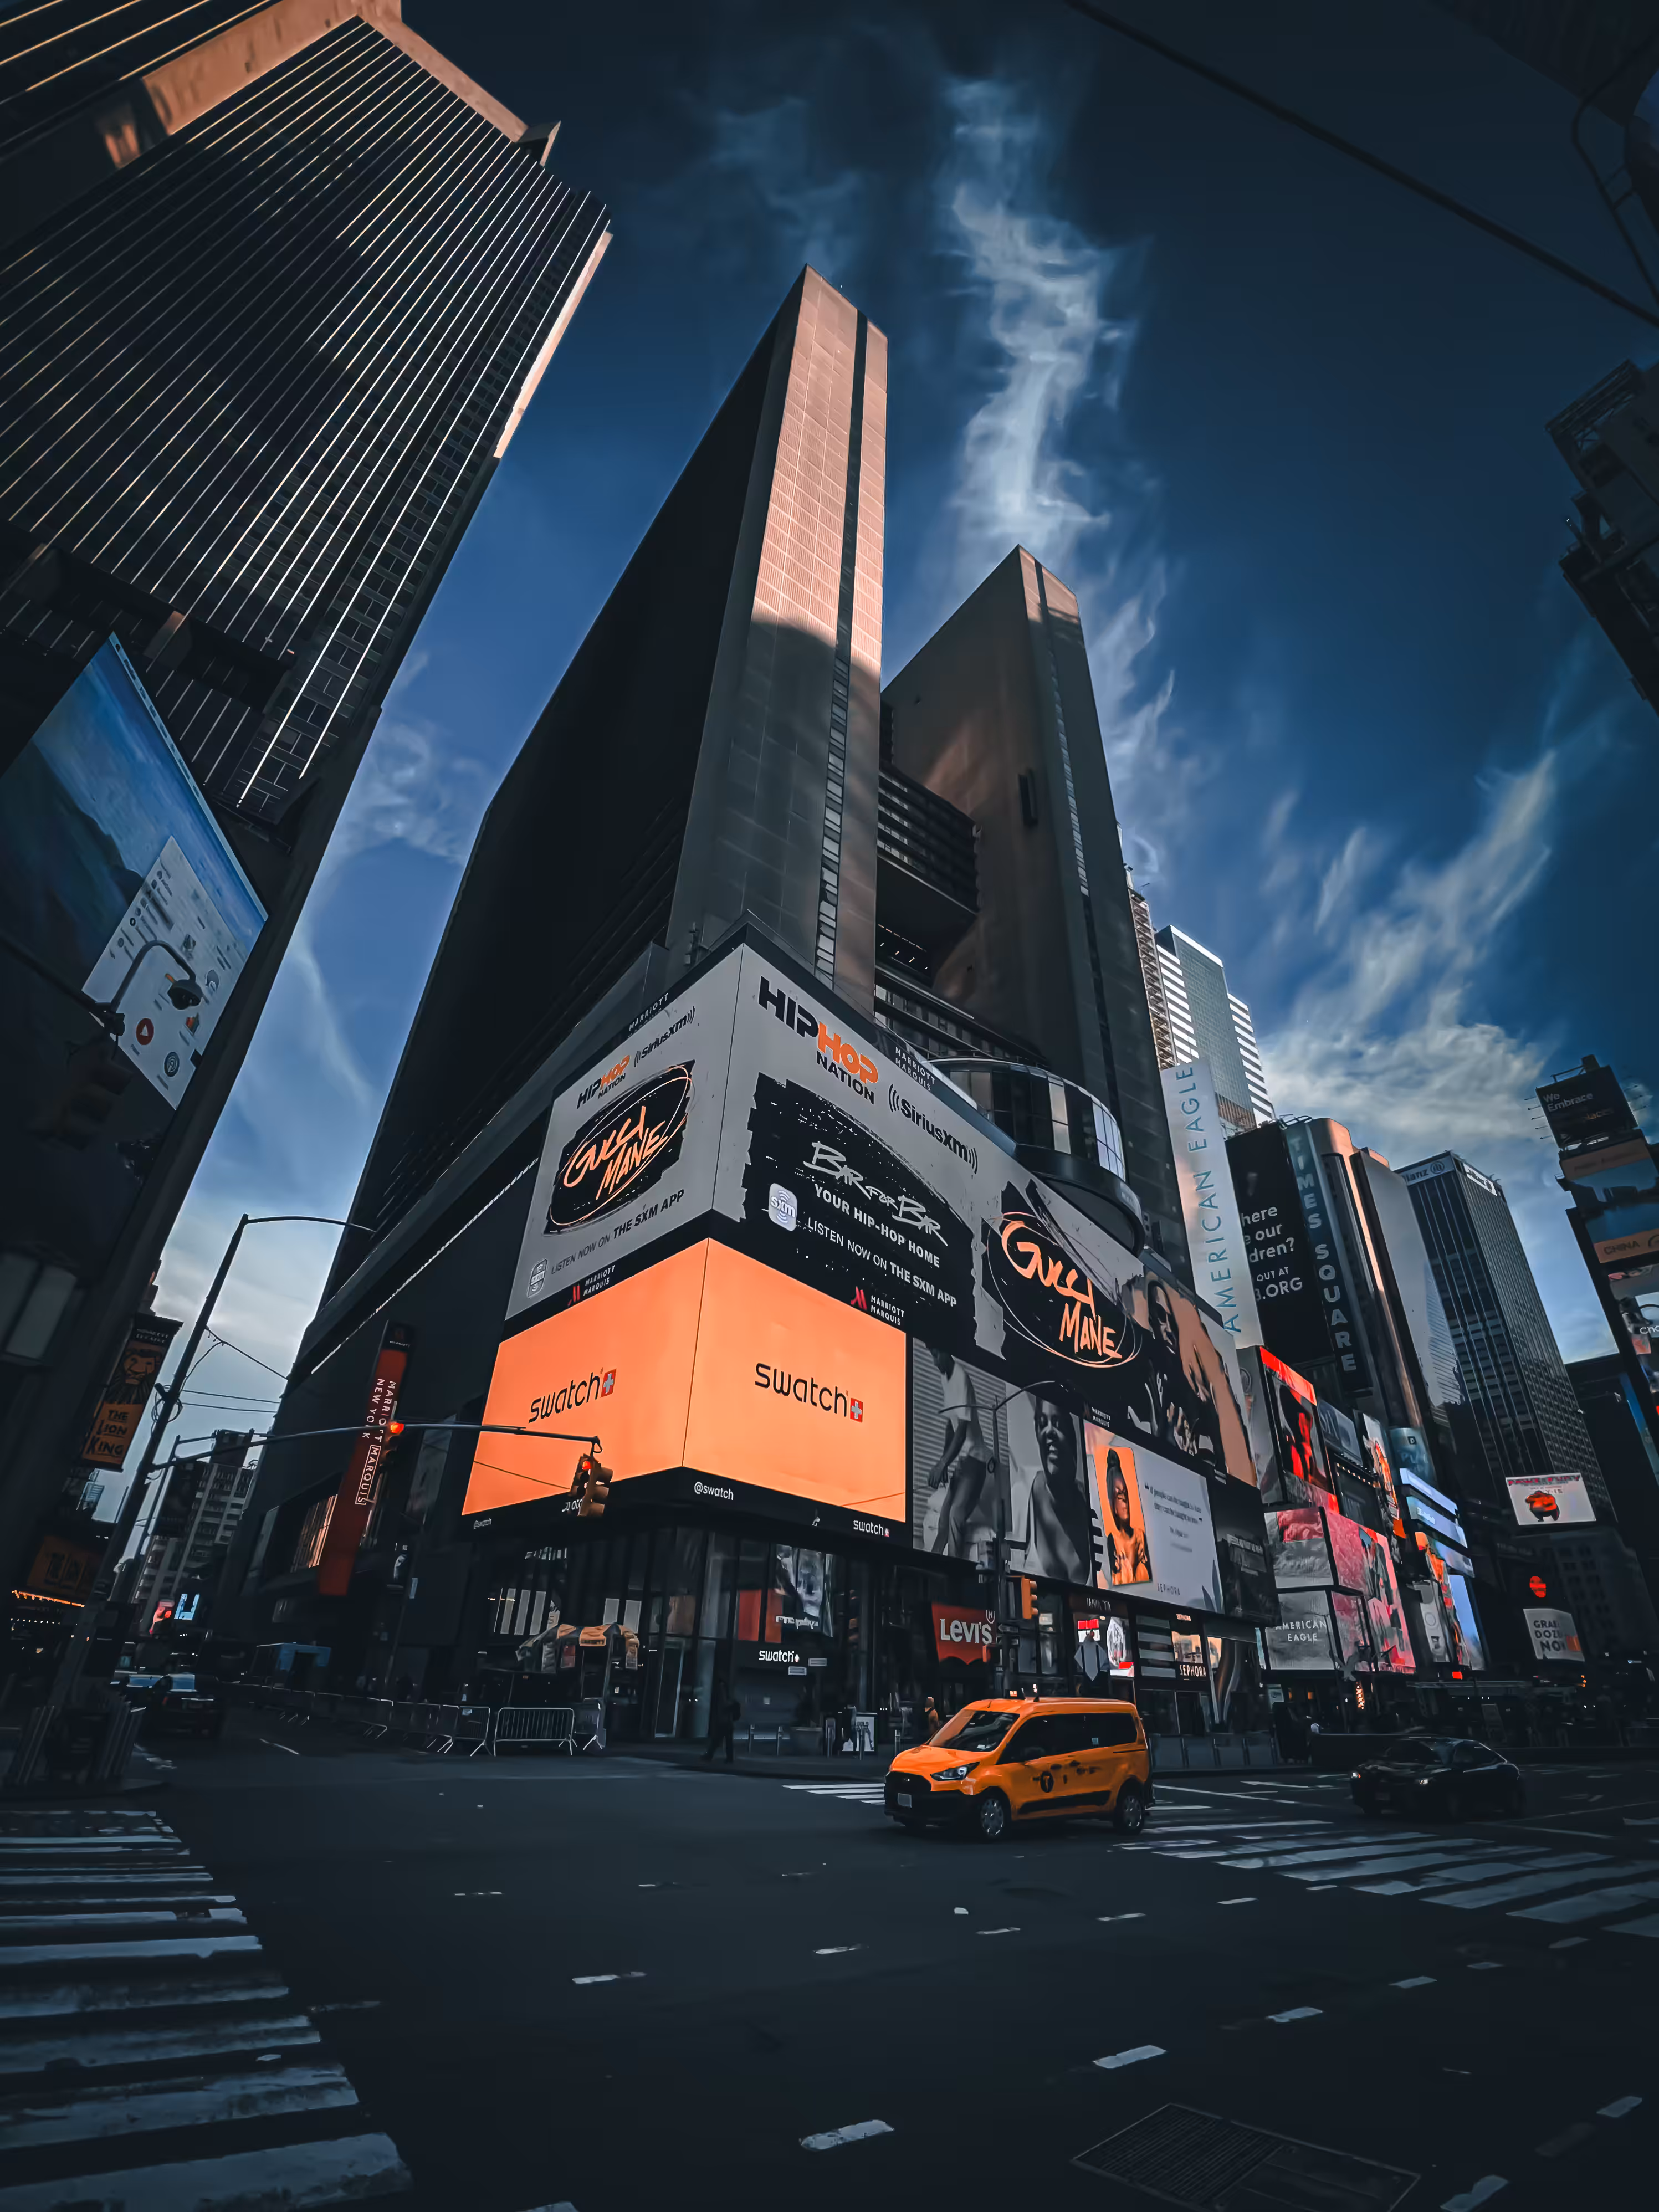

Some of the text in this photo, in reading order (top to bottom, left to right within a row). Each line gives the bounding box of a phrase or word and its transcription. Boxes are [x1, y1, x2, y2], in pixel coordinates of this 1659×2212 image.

[628, 992, 669, 1032] MARRIOTT
[895, 1047, 936, 1084] MARRIOTT
[895, 1058, 931, 1092] MARQUIS
[597, 1072, 626, 1100] NATION
[816, 1051, 875, 1105] NATION
[1542, 1093, 1561, 1104] We
[1547, 1092, 1594, 1113] Embrace
[770, 1195, 797, 1218] sxm
[1175, 1066, 1242, 1334] AMERICAN EAGLE
[814, 1183, 940, 1269] YOUR HIP-HOP HOME
[1241, 1206, 1278, 1227] here
[551, 1189, 685, 1275] LISTEN NOW ON THE SXM APP
[1255, 1223, 1283, 1241] our
[1248, 1236, 1295, 1263] dren?
[1289, 1135, 1358, 1373] TIMES SQUARE
[1604, 1240, 1641, 1255] CHINA
[807, 1217, 957, 1308] LISTEN NOW ON THE SXM APP
[1256, 1266, 1289, 1282] OUT AT
[582, 1277, 611, 1297] MARQUIS
[585, 1264, 616, 1287] MARRIOTT
[870, 1305, 902, 1326] MARQUIS
[871, 1294, 905, 1319] MARRIOTT
[528, 1371, 601, 1424] swatch
[755, 1362, 847, 1419] swatch
[108, 1409, 129, 1422] THE
[361, 1378, 386, 1440] NEW YOK
[96, 1419, 128, 1436] LION
[86, 1435, 125, 1456] KING
[357, 1447, 380, 1503] MARQUIS
[694, 1481, 734, 1501] @swatch
[853, 1519, 884, 1537] swatch
[1157, 1583, 1181, 1596] SEPHORA
[1287, 1632, 1318, 1642] EAGLE
[759, 1649, 795, 1663] swatch
[1179, 1663, 1207, 1678] SEPHORA
